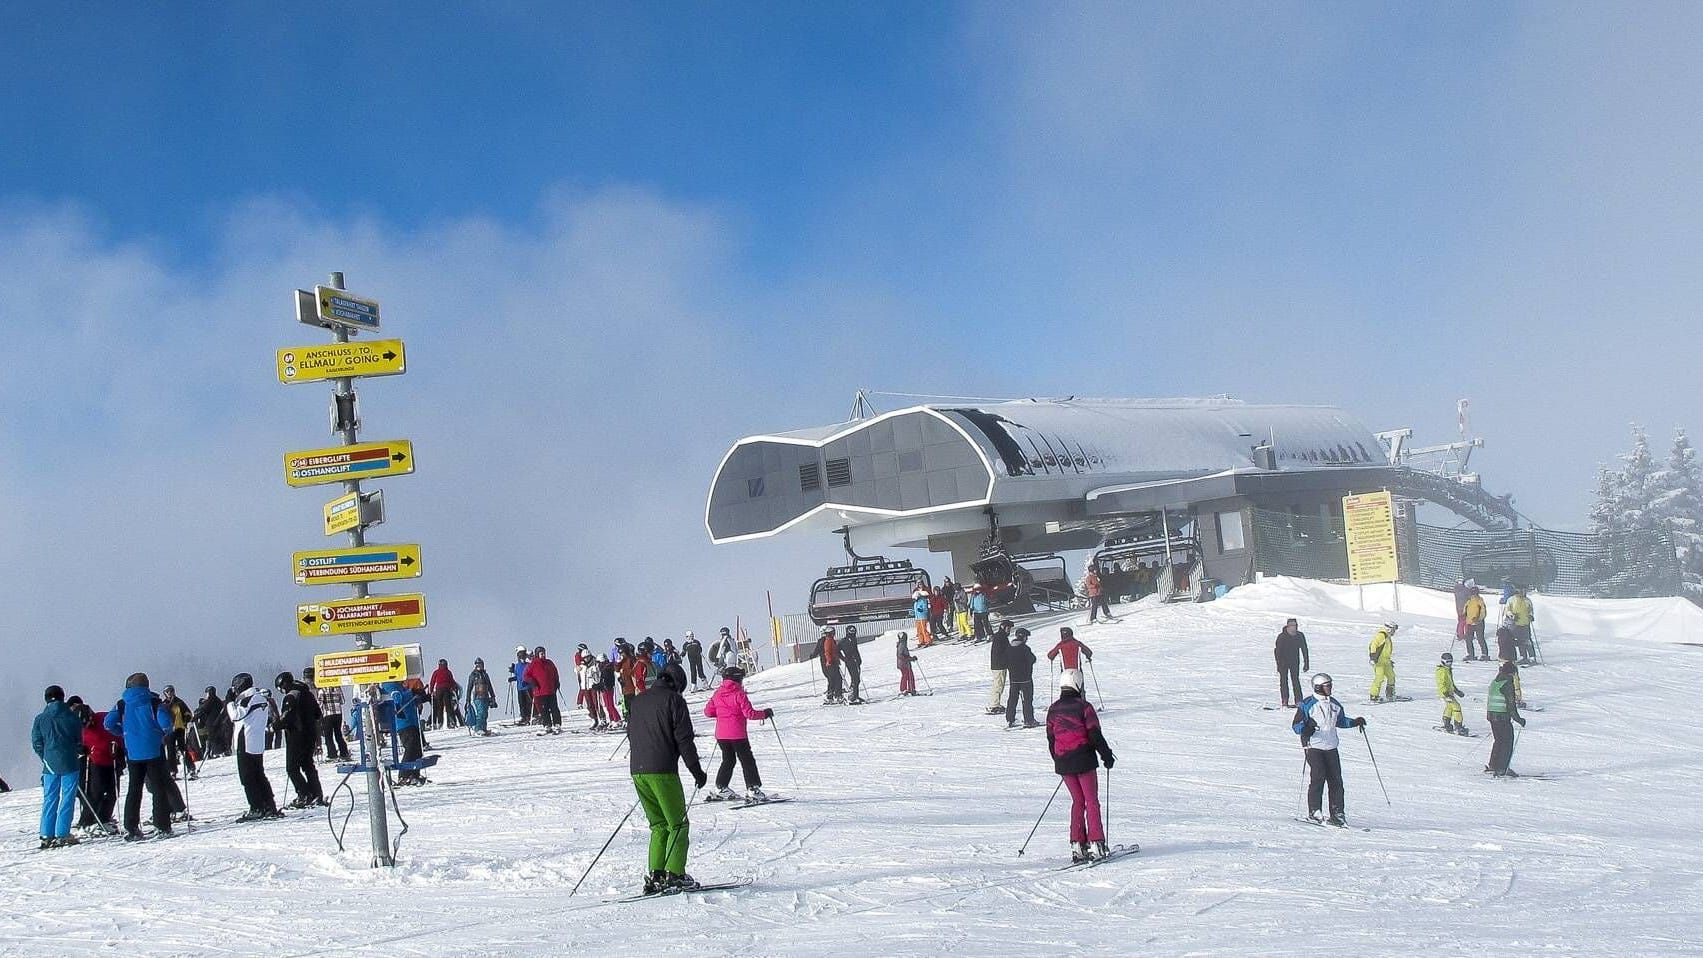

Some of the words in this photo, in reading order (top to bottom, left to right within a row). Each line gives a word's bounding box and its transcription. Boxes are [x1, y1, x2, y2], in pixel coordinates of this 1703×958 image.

[305, 349, 352, 359] ANSCHLUSS
[299, 358, 336, 369] ELLMAU
[344, 354, 380, 365] GOING
[308, 454, 351, 465] EIBERGLIFTE
[301, 465, 351, 477] OSTHANGLIFT
[308, 557, 337, 566] OSTLIFT
[308, 567, 348, 577] VERBINDUNG
[349, 564, 397, 574] SÜDHANGBAHN
[336, 604, 378, 614] JOCHABFAHRT
[336, 611, 372, 620] TALABFAHRT
